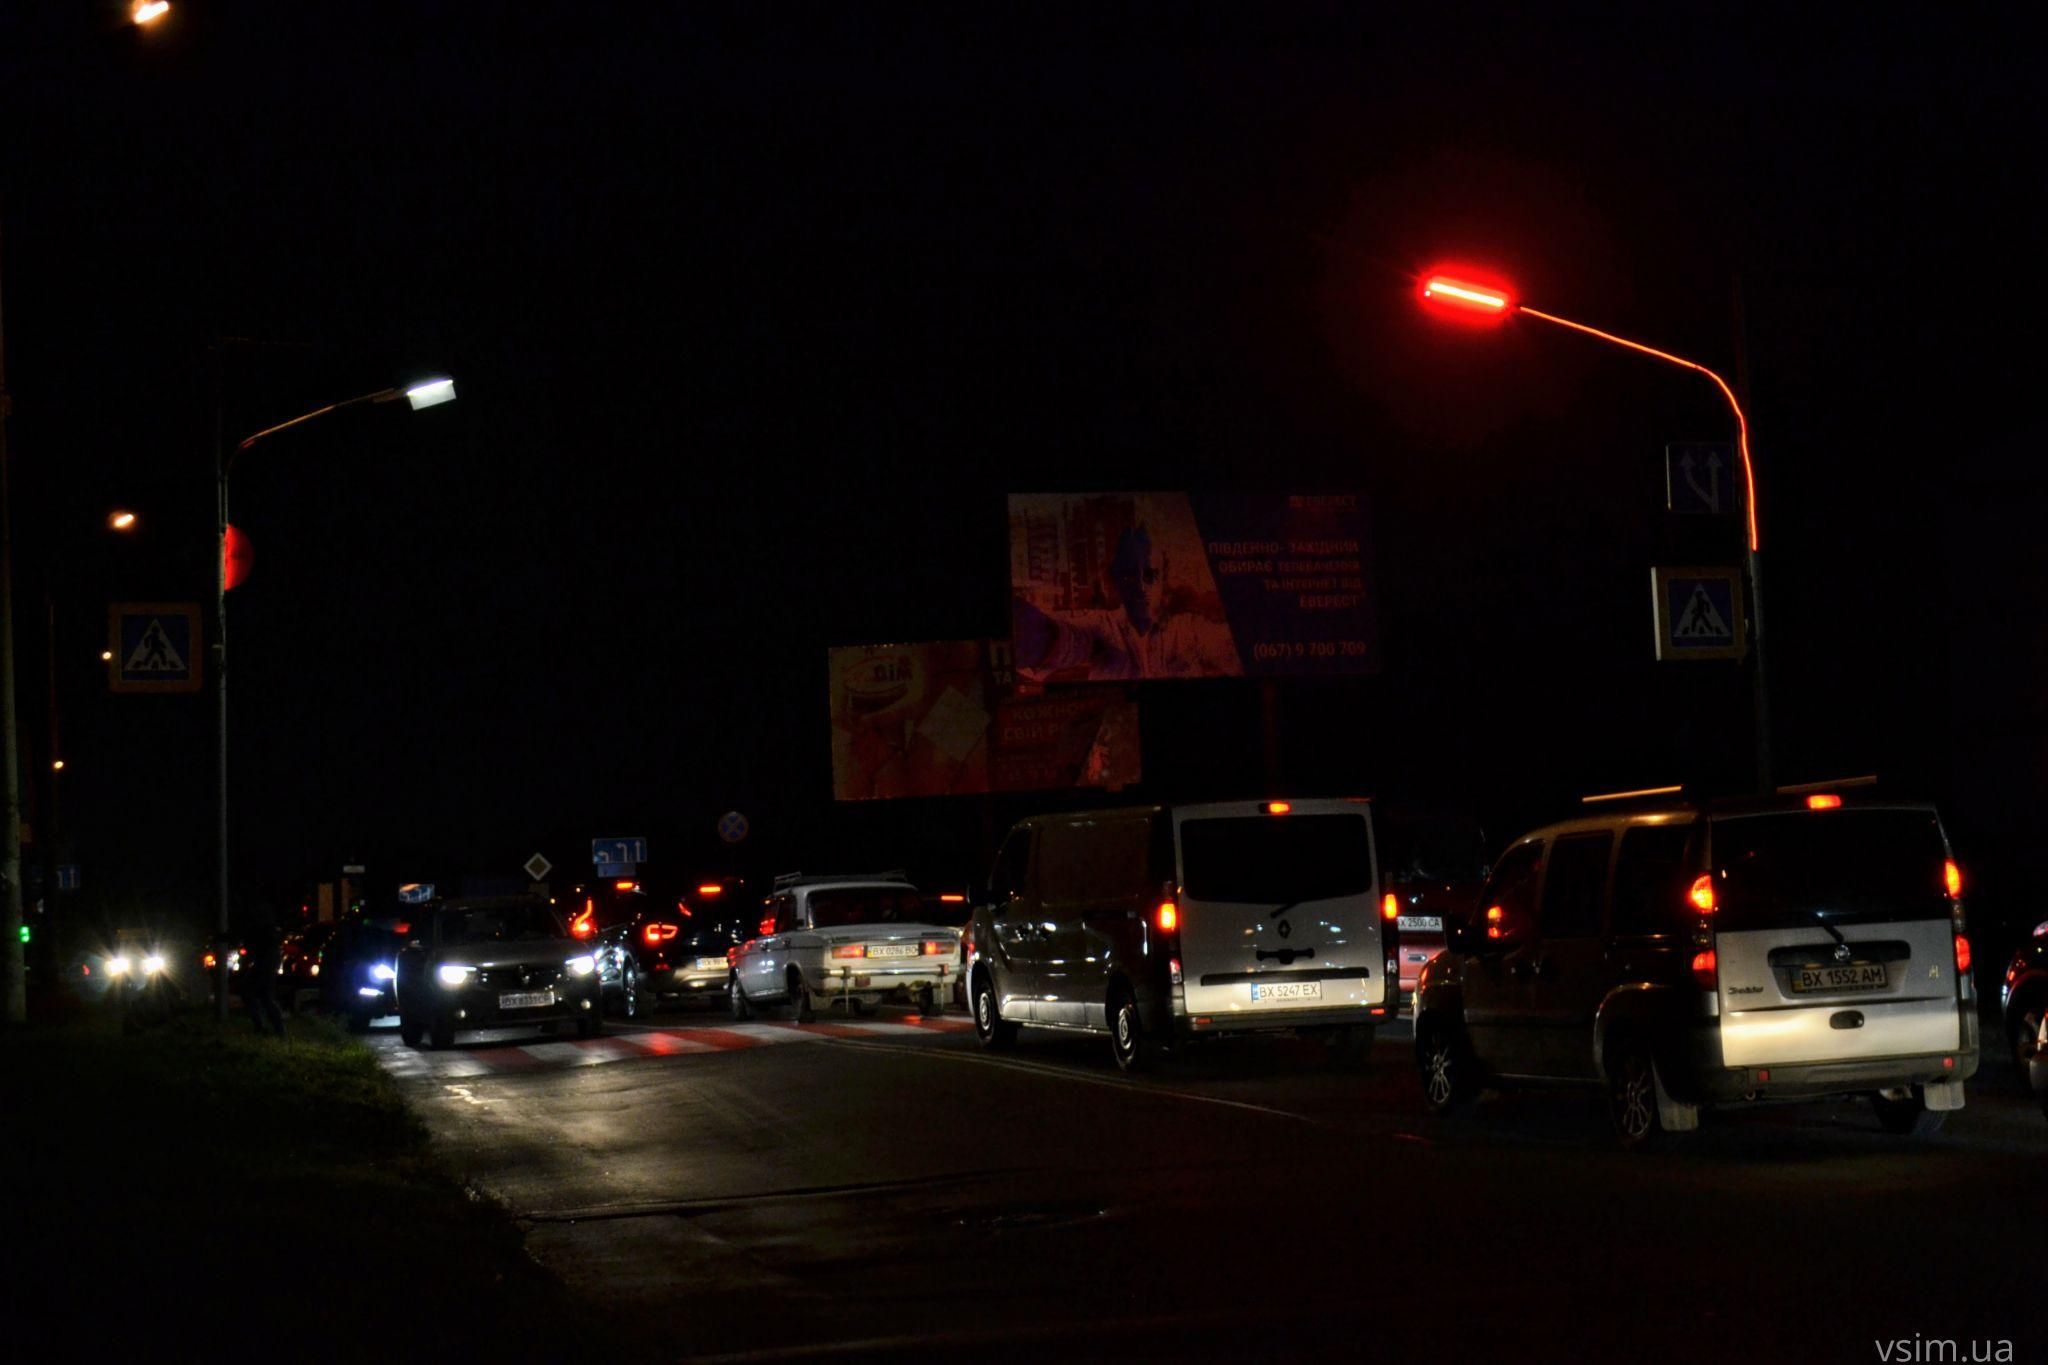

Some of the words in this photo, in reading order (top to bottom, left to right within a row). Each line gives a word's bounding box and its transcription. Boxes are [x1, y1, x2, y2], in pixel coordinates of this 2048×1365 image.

[1802, 972, 1822, 987] BX
[1826, 970, 1857, 986] 1552
[1860, 968, 1882, 985] AM
[1259, 987, 1275, 999] BX
[1276, 985, 1301, 998] 5247
[1302, 983, 1318, 996] EX
